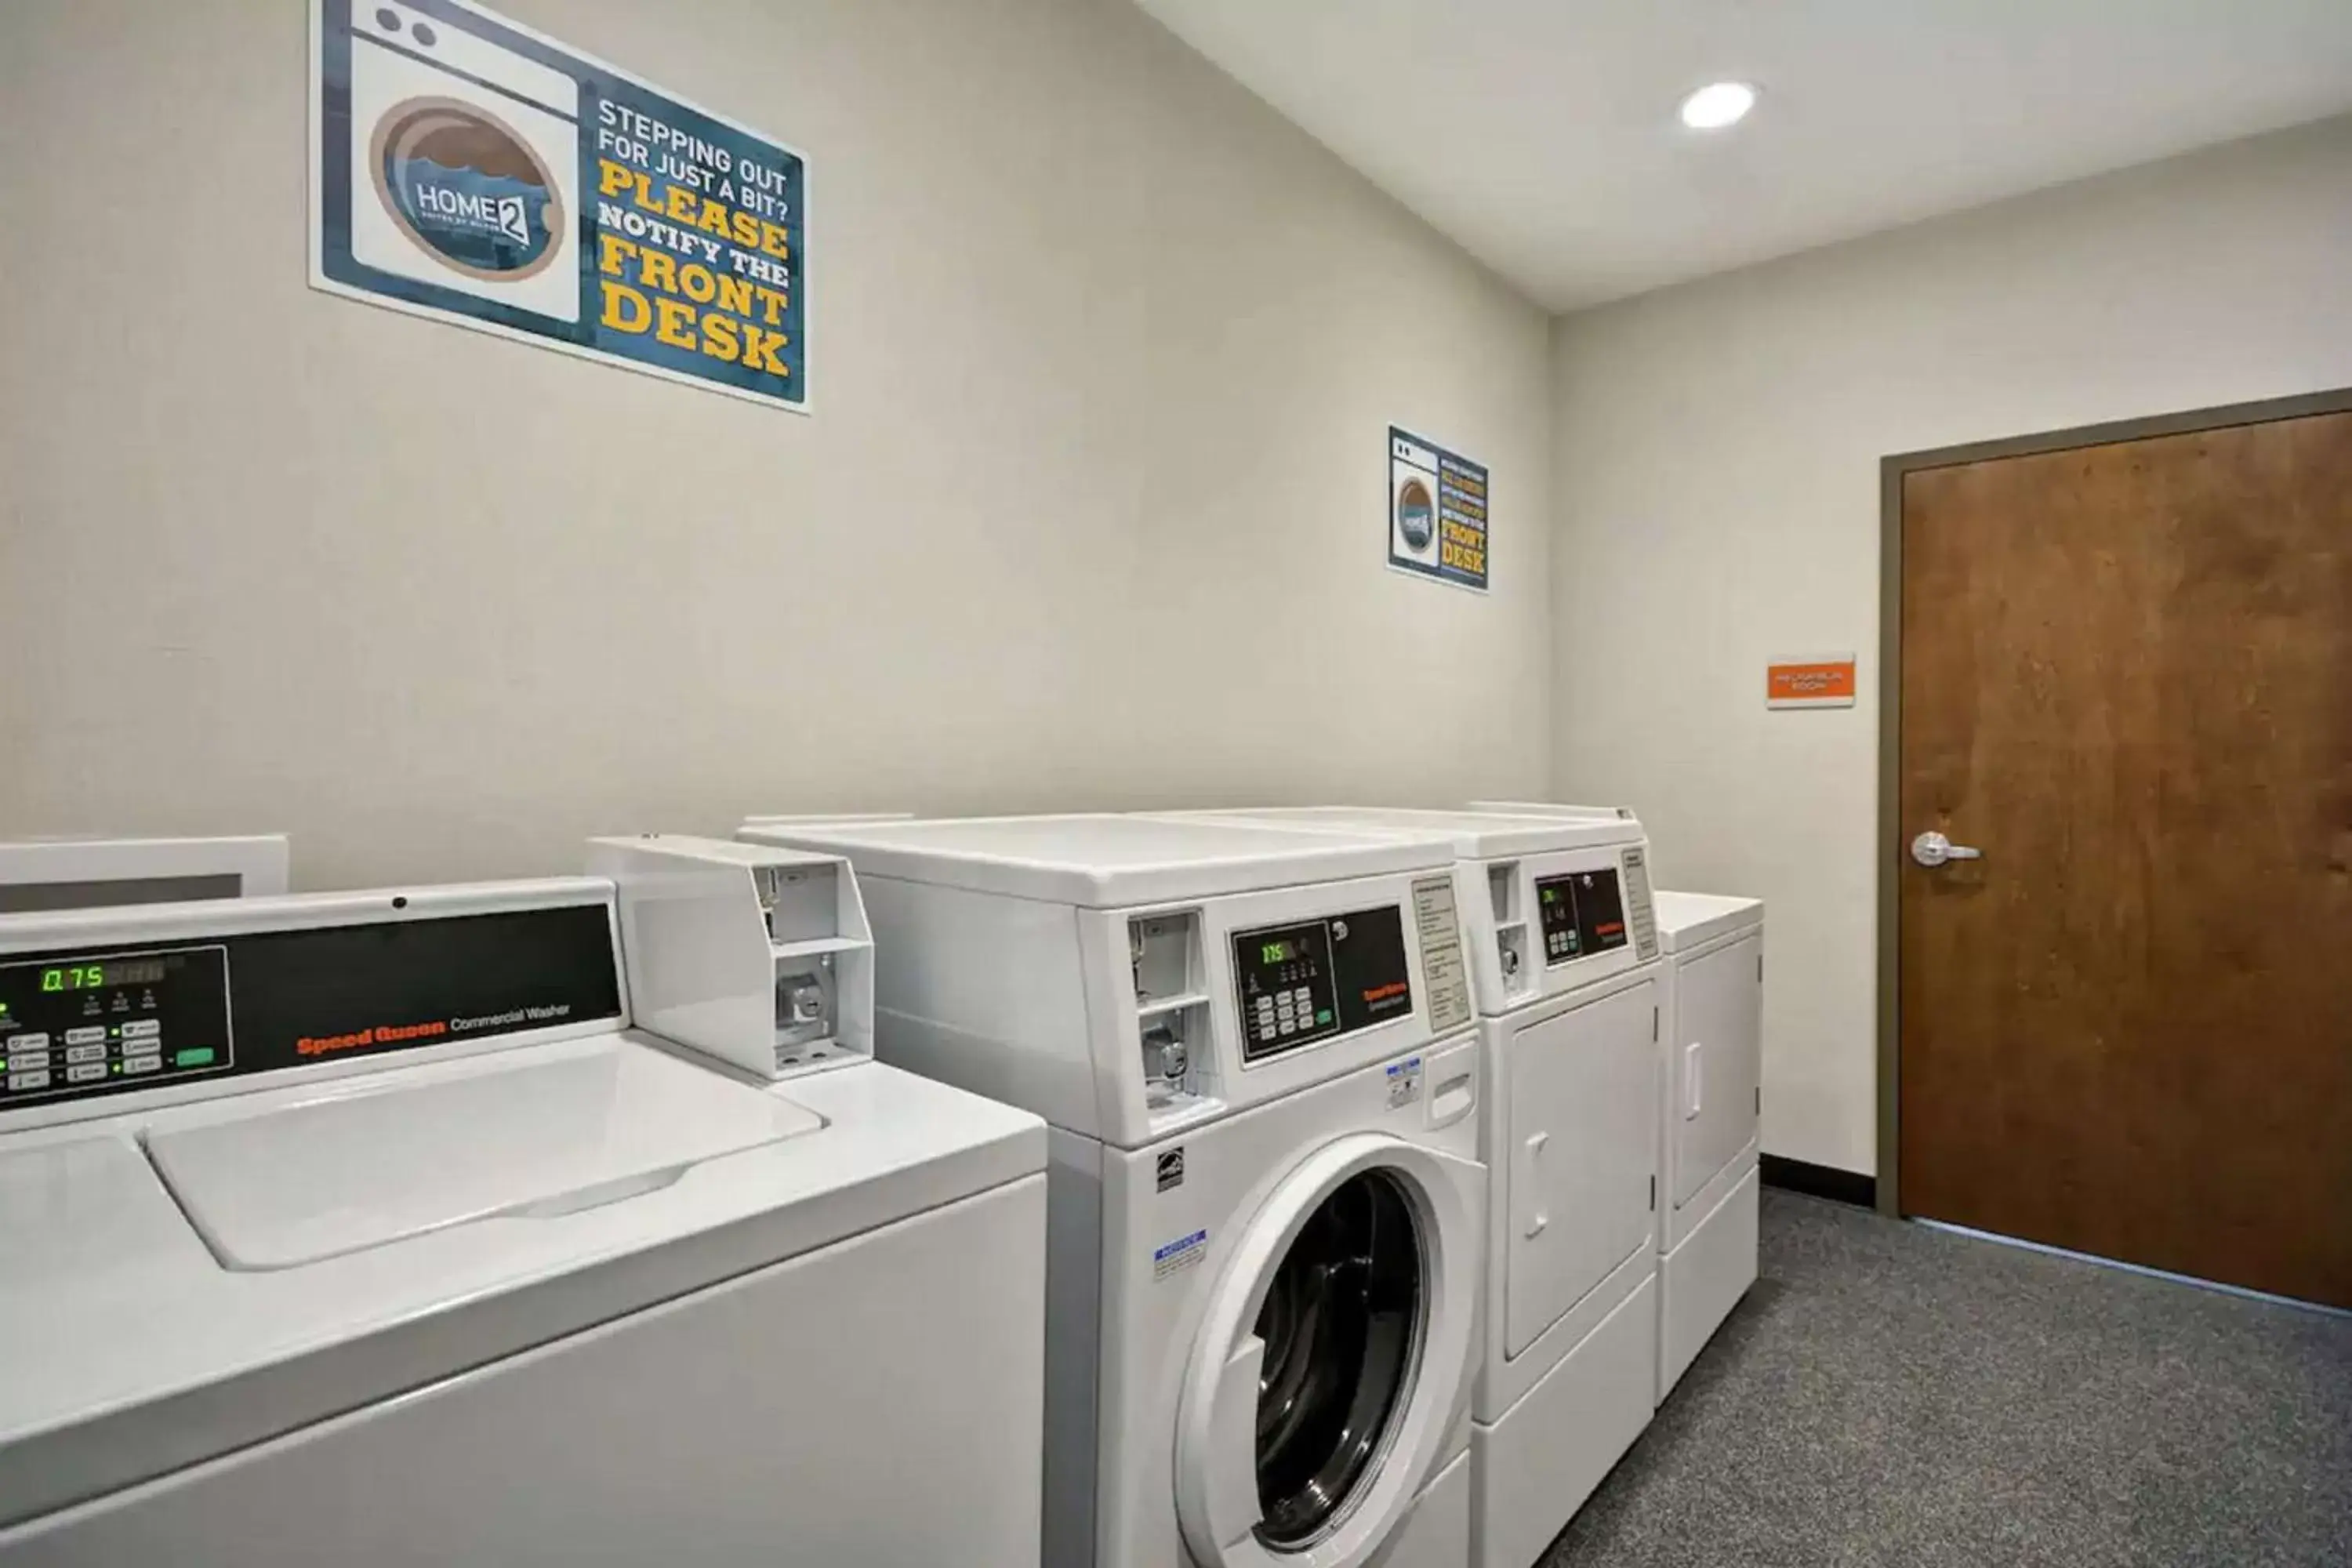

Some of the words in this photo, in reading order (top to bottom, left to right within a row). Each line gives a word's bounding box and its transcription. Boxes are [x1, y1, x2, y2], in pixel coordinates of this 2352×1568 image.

[599, 99, 731, 173] STEPPING
[739, 159, 786, 195] OUT
[599, 128, 649, 168] FOR
[655, 153, 715, 192] JUST
[719, 179, 735, 201] A
[741, 186, 789, 221] BIT?
[597, 201, 722, 263] NOTIFY
[729, 249, 789, 288] THE
[598, 158, 789, 259] PLEASE
[600, 234, 789, 326] FRONT
[601, 279, 790, 377] DESK
[1442, 539, 1485, 574] DESK
[296, 1029, 372, 1054] Speed
[376, 1020, 446, 1042] Queen
[449, 1009, 524, 1032] Commercial
[525, 1004, 571, 1020] Washer
